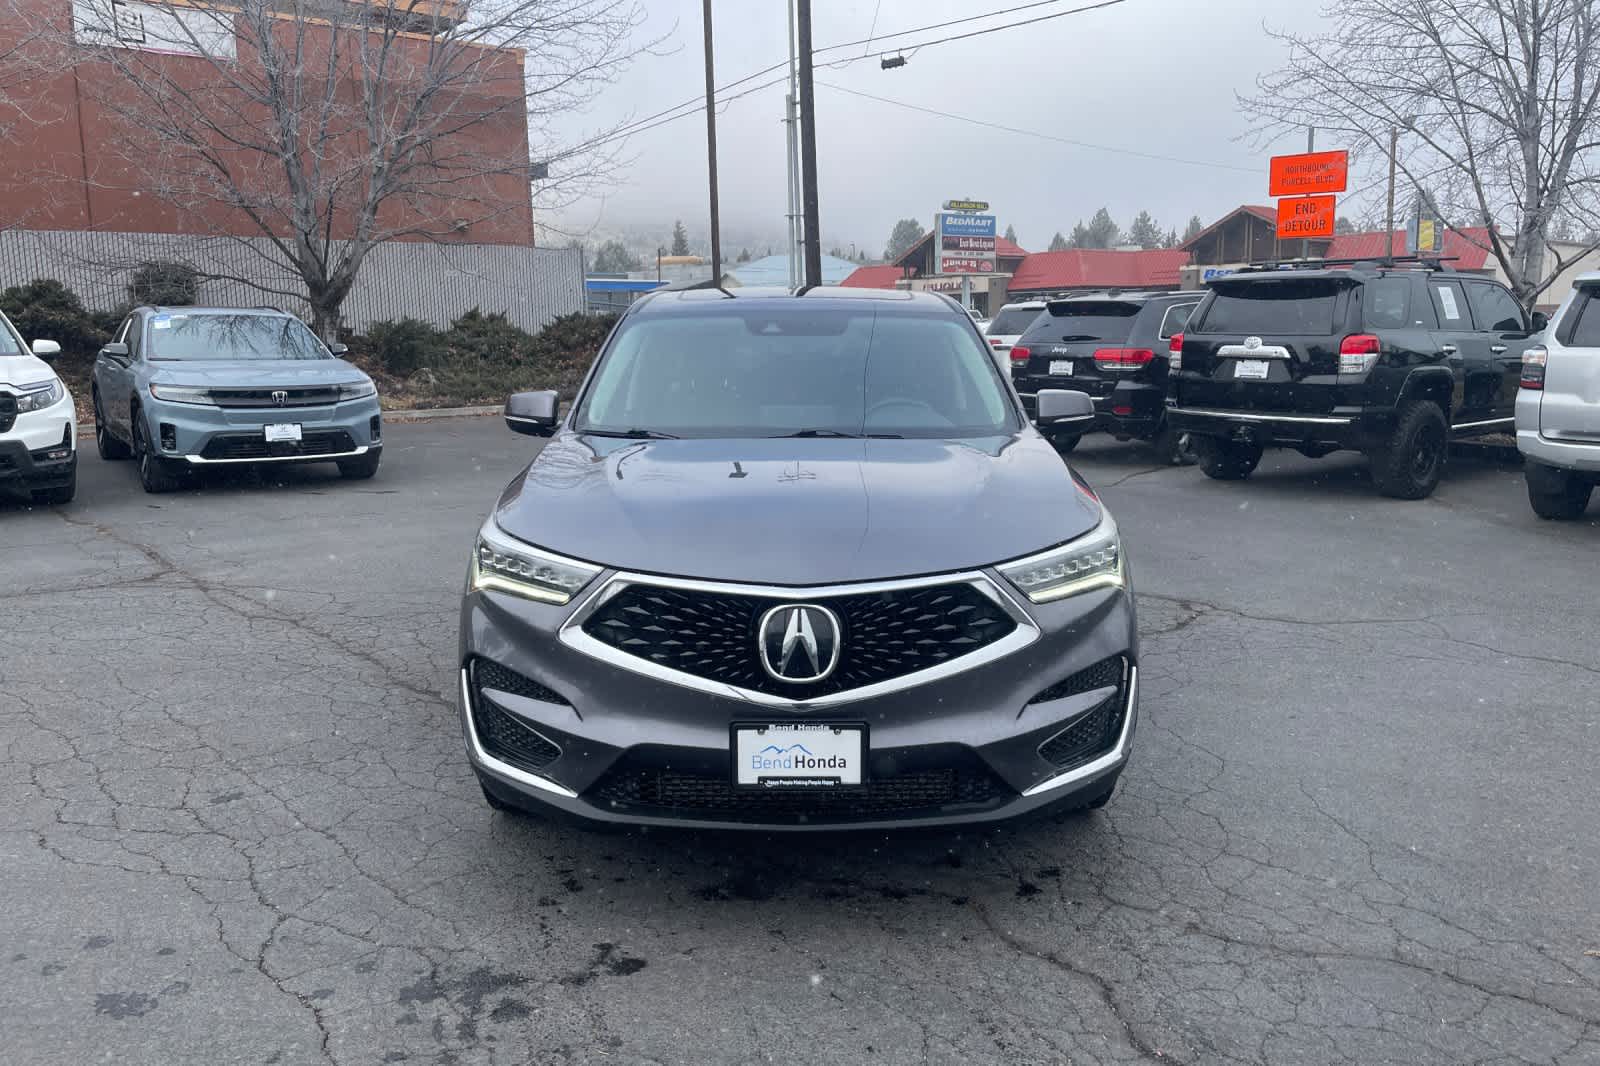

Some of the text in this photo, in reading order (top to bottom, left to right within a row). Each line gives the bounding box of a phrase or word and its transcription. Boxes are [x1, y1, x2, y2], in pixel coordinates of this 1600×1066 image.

[1295, 202, 1316, 215] END
[1285, 219, 1326, 232] DETOUR
[1051, 346, 1068, 355] Jeep
[768, 724, 830, 732] Bend Honda
